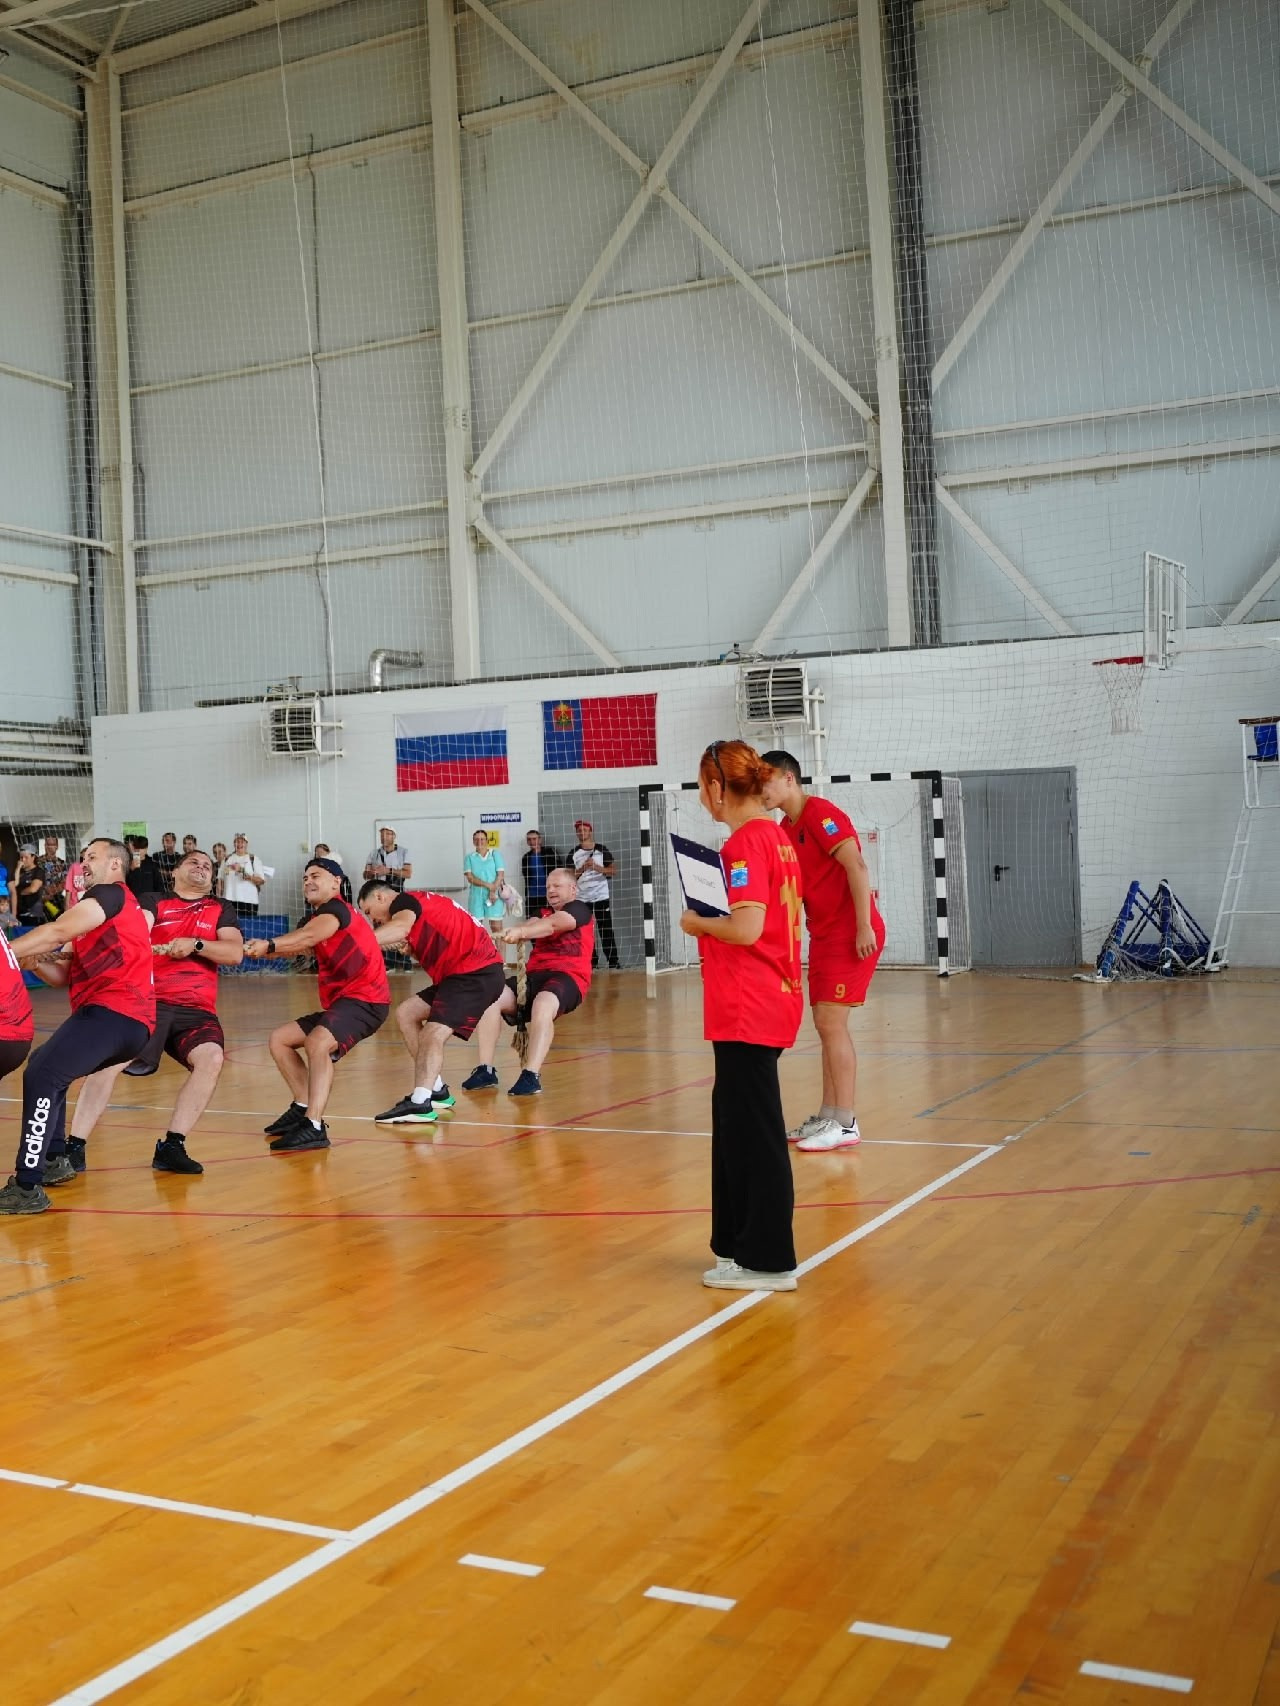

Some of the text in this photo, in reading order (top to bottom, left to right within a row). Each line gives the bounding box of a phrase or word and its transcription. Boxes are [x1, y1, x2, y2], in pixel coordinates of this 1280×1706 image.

[481, 813, 520, 822] ИНФОРМАЦИЯ
[834, 983, 846, 999] 9
[24, 1097, 51, 1169] adidas
